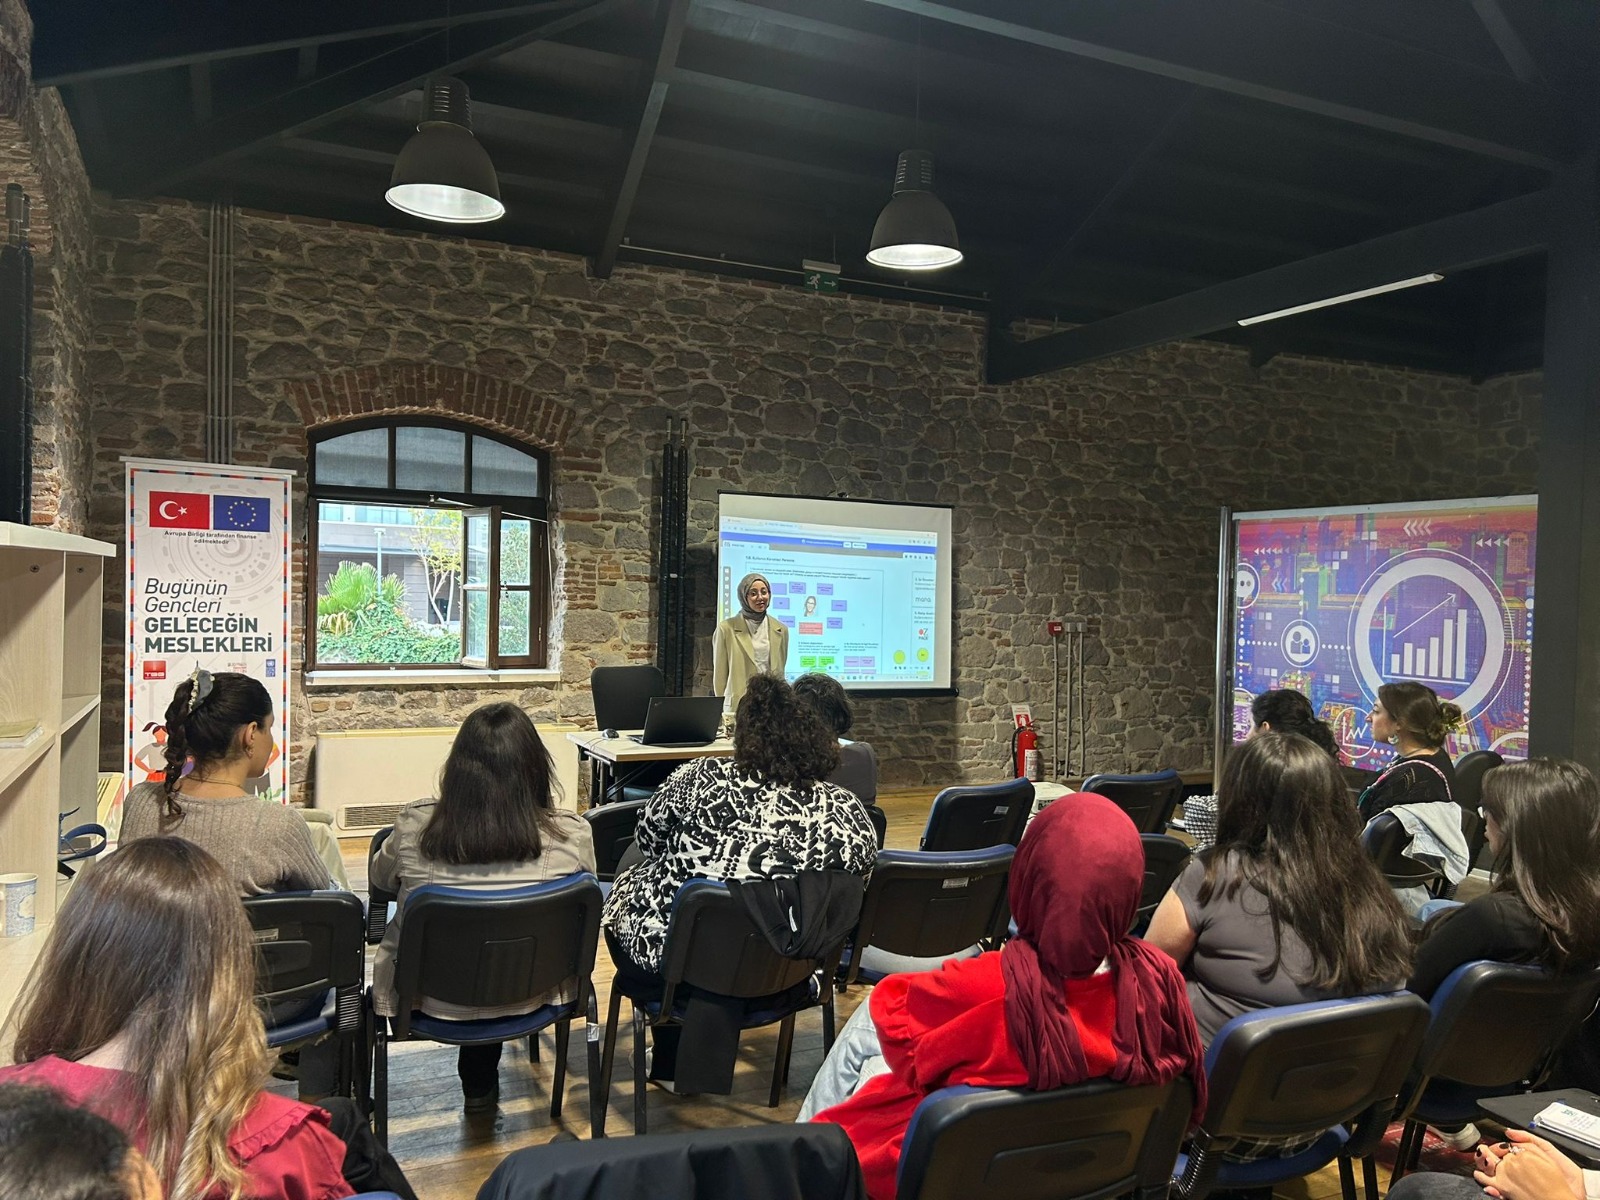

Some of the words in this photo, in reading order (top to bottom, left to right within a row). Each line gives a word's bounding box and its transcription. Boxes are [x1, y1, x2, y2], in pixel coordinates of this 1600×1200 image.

[144, 578, 228, 598] Bugünün
[144, 597, 222, 617] Gençleri
[144, 613, 258, 633] GELECEĞİN
[144, 632, 272, 653] MESLEKLERİ
